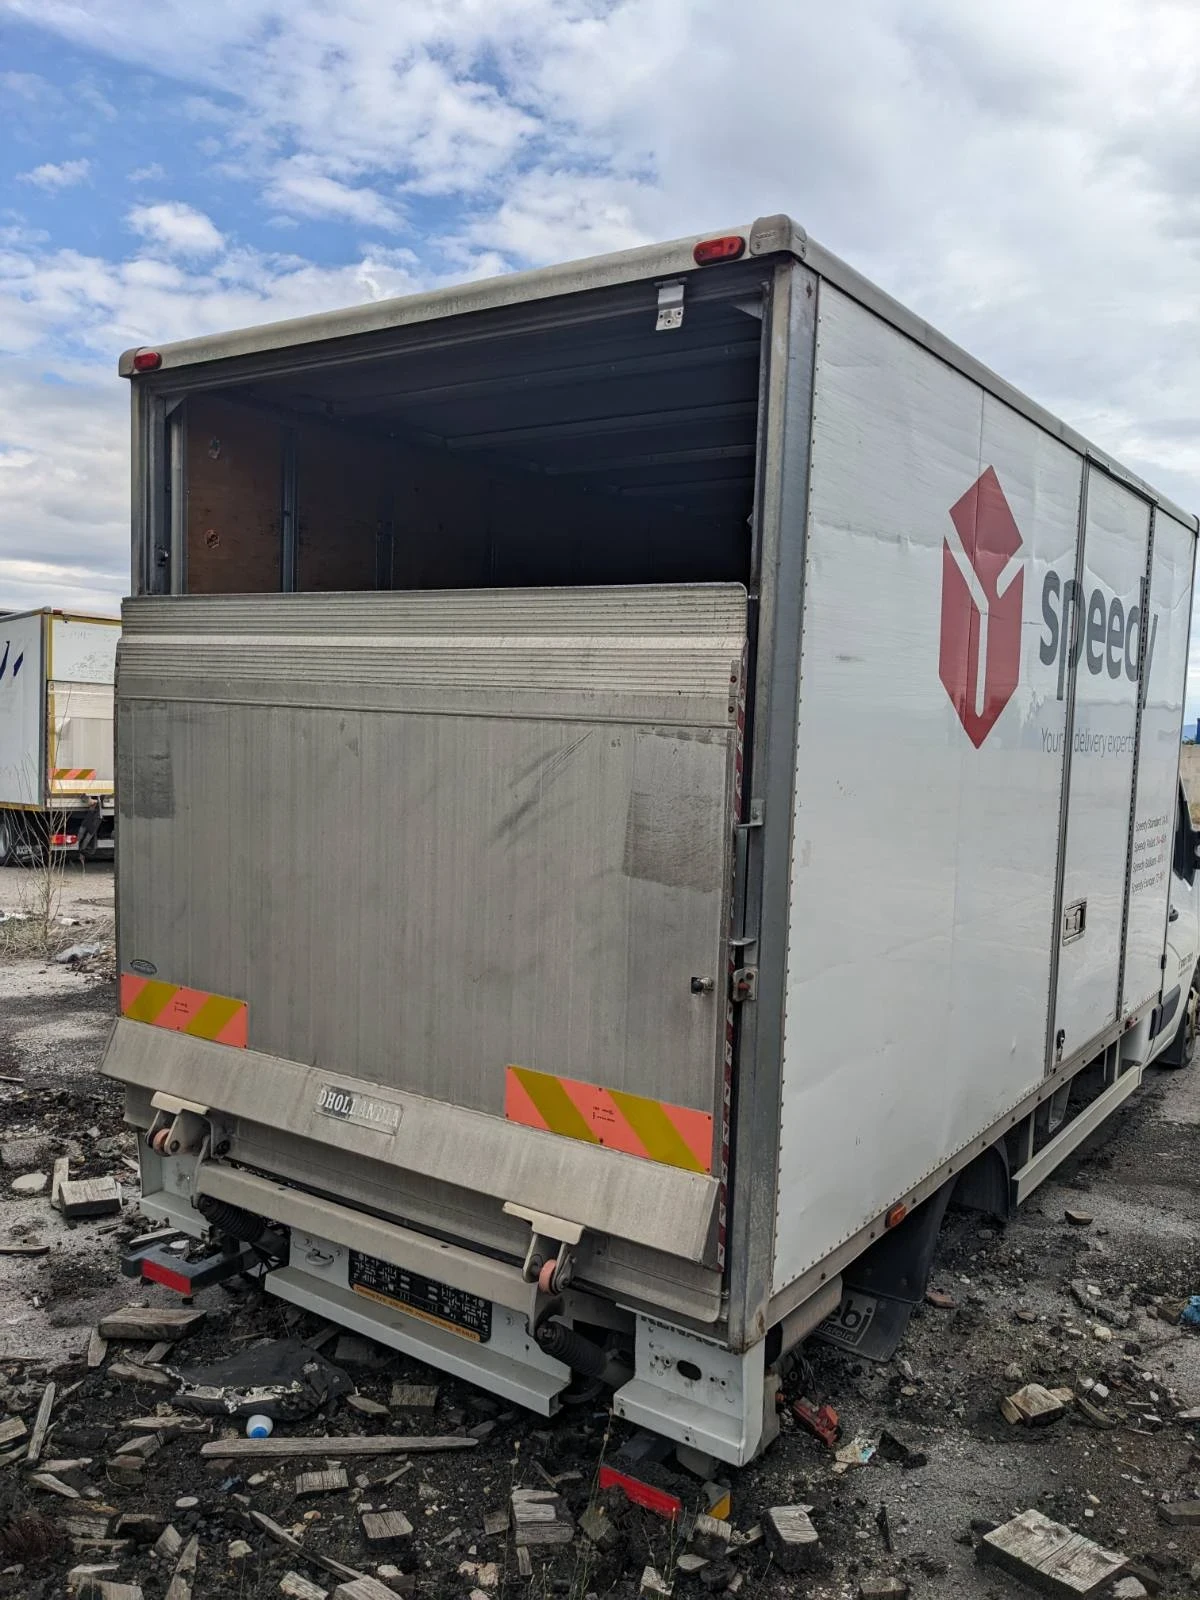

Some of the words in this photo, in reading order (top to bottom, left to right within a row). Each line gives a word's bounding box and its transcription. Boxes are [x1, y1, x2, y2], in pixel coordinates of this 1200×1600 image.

[1041, 727, 1063, 754] Your
[1074, 727, 1107, 758] delivery
[317, 1087, 400, 1129] DHOLLANDIA
